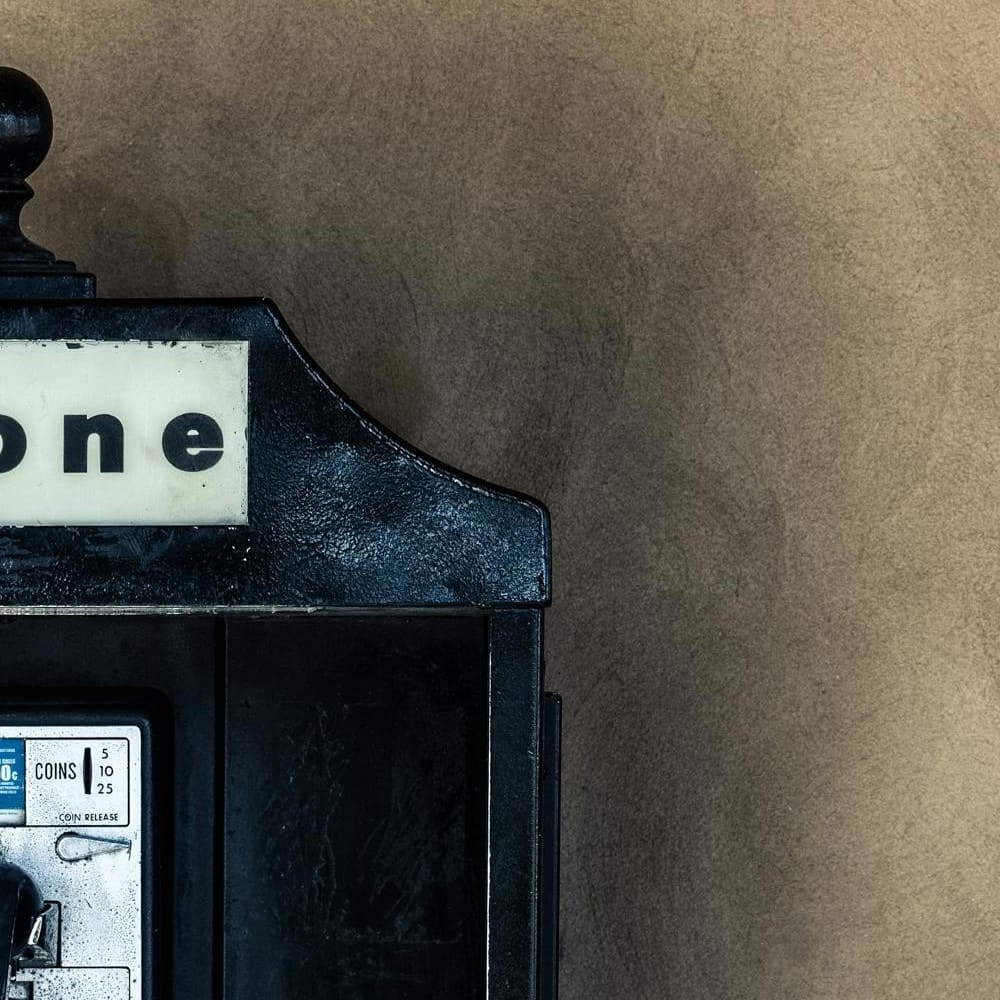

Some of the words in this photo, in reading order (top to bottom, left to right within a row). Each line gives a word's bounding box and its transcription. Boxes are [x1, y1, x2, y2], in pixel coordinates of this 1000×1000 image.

[101, 747, 109, 760] 5
[35, 762, 77, 780] COINS
[99, 765, 114, 777] 10
[96, 783, 114, 794] 25
[59, 813, 81, 821] COIN
[84, 813, 119, 821] RELEASE
